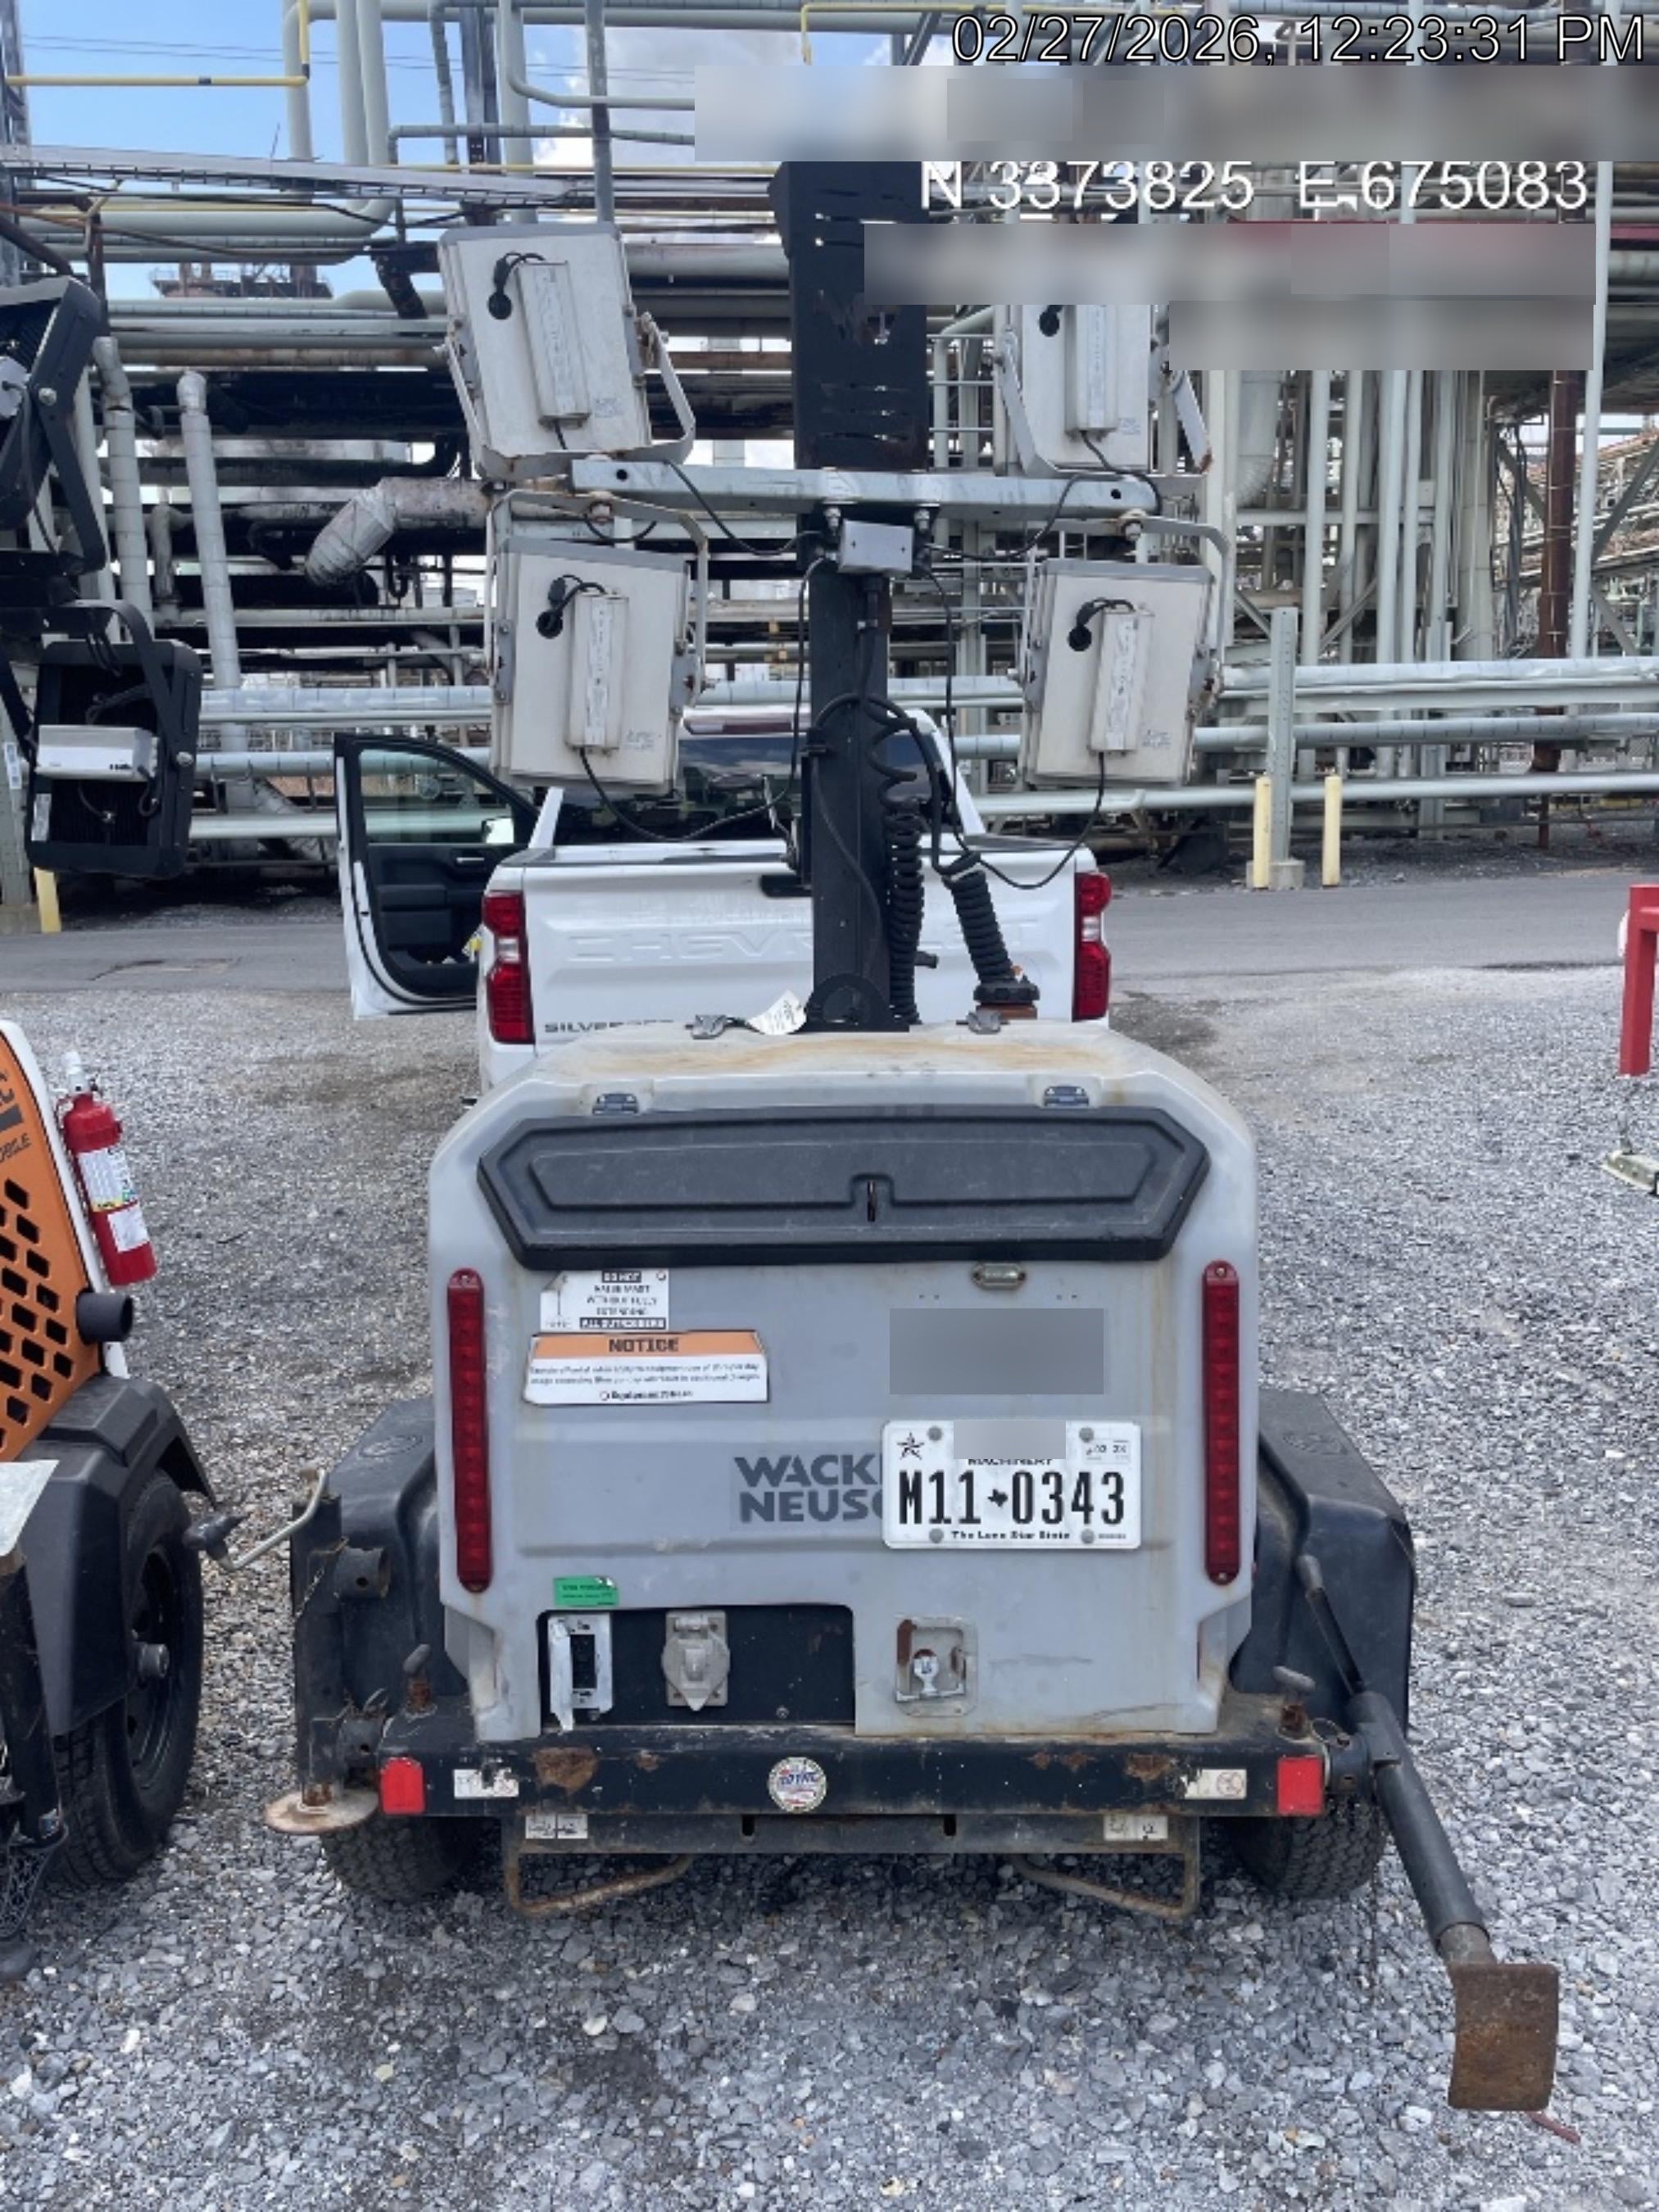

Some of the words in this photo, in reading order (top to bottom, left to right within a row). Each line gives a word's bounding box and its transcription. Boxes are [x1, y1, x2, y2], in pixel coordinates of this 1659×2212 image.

[608, 1339, 679, 1353] NOTICE
[734, 1453, 882, 1488] WACK
[900, 1471, 981, 1525] M11
[1012, 1471, 1124, 1525] 0343
[951, 1530, 974, 1539] The
